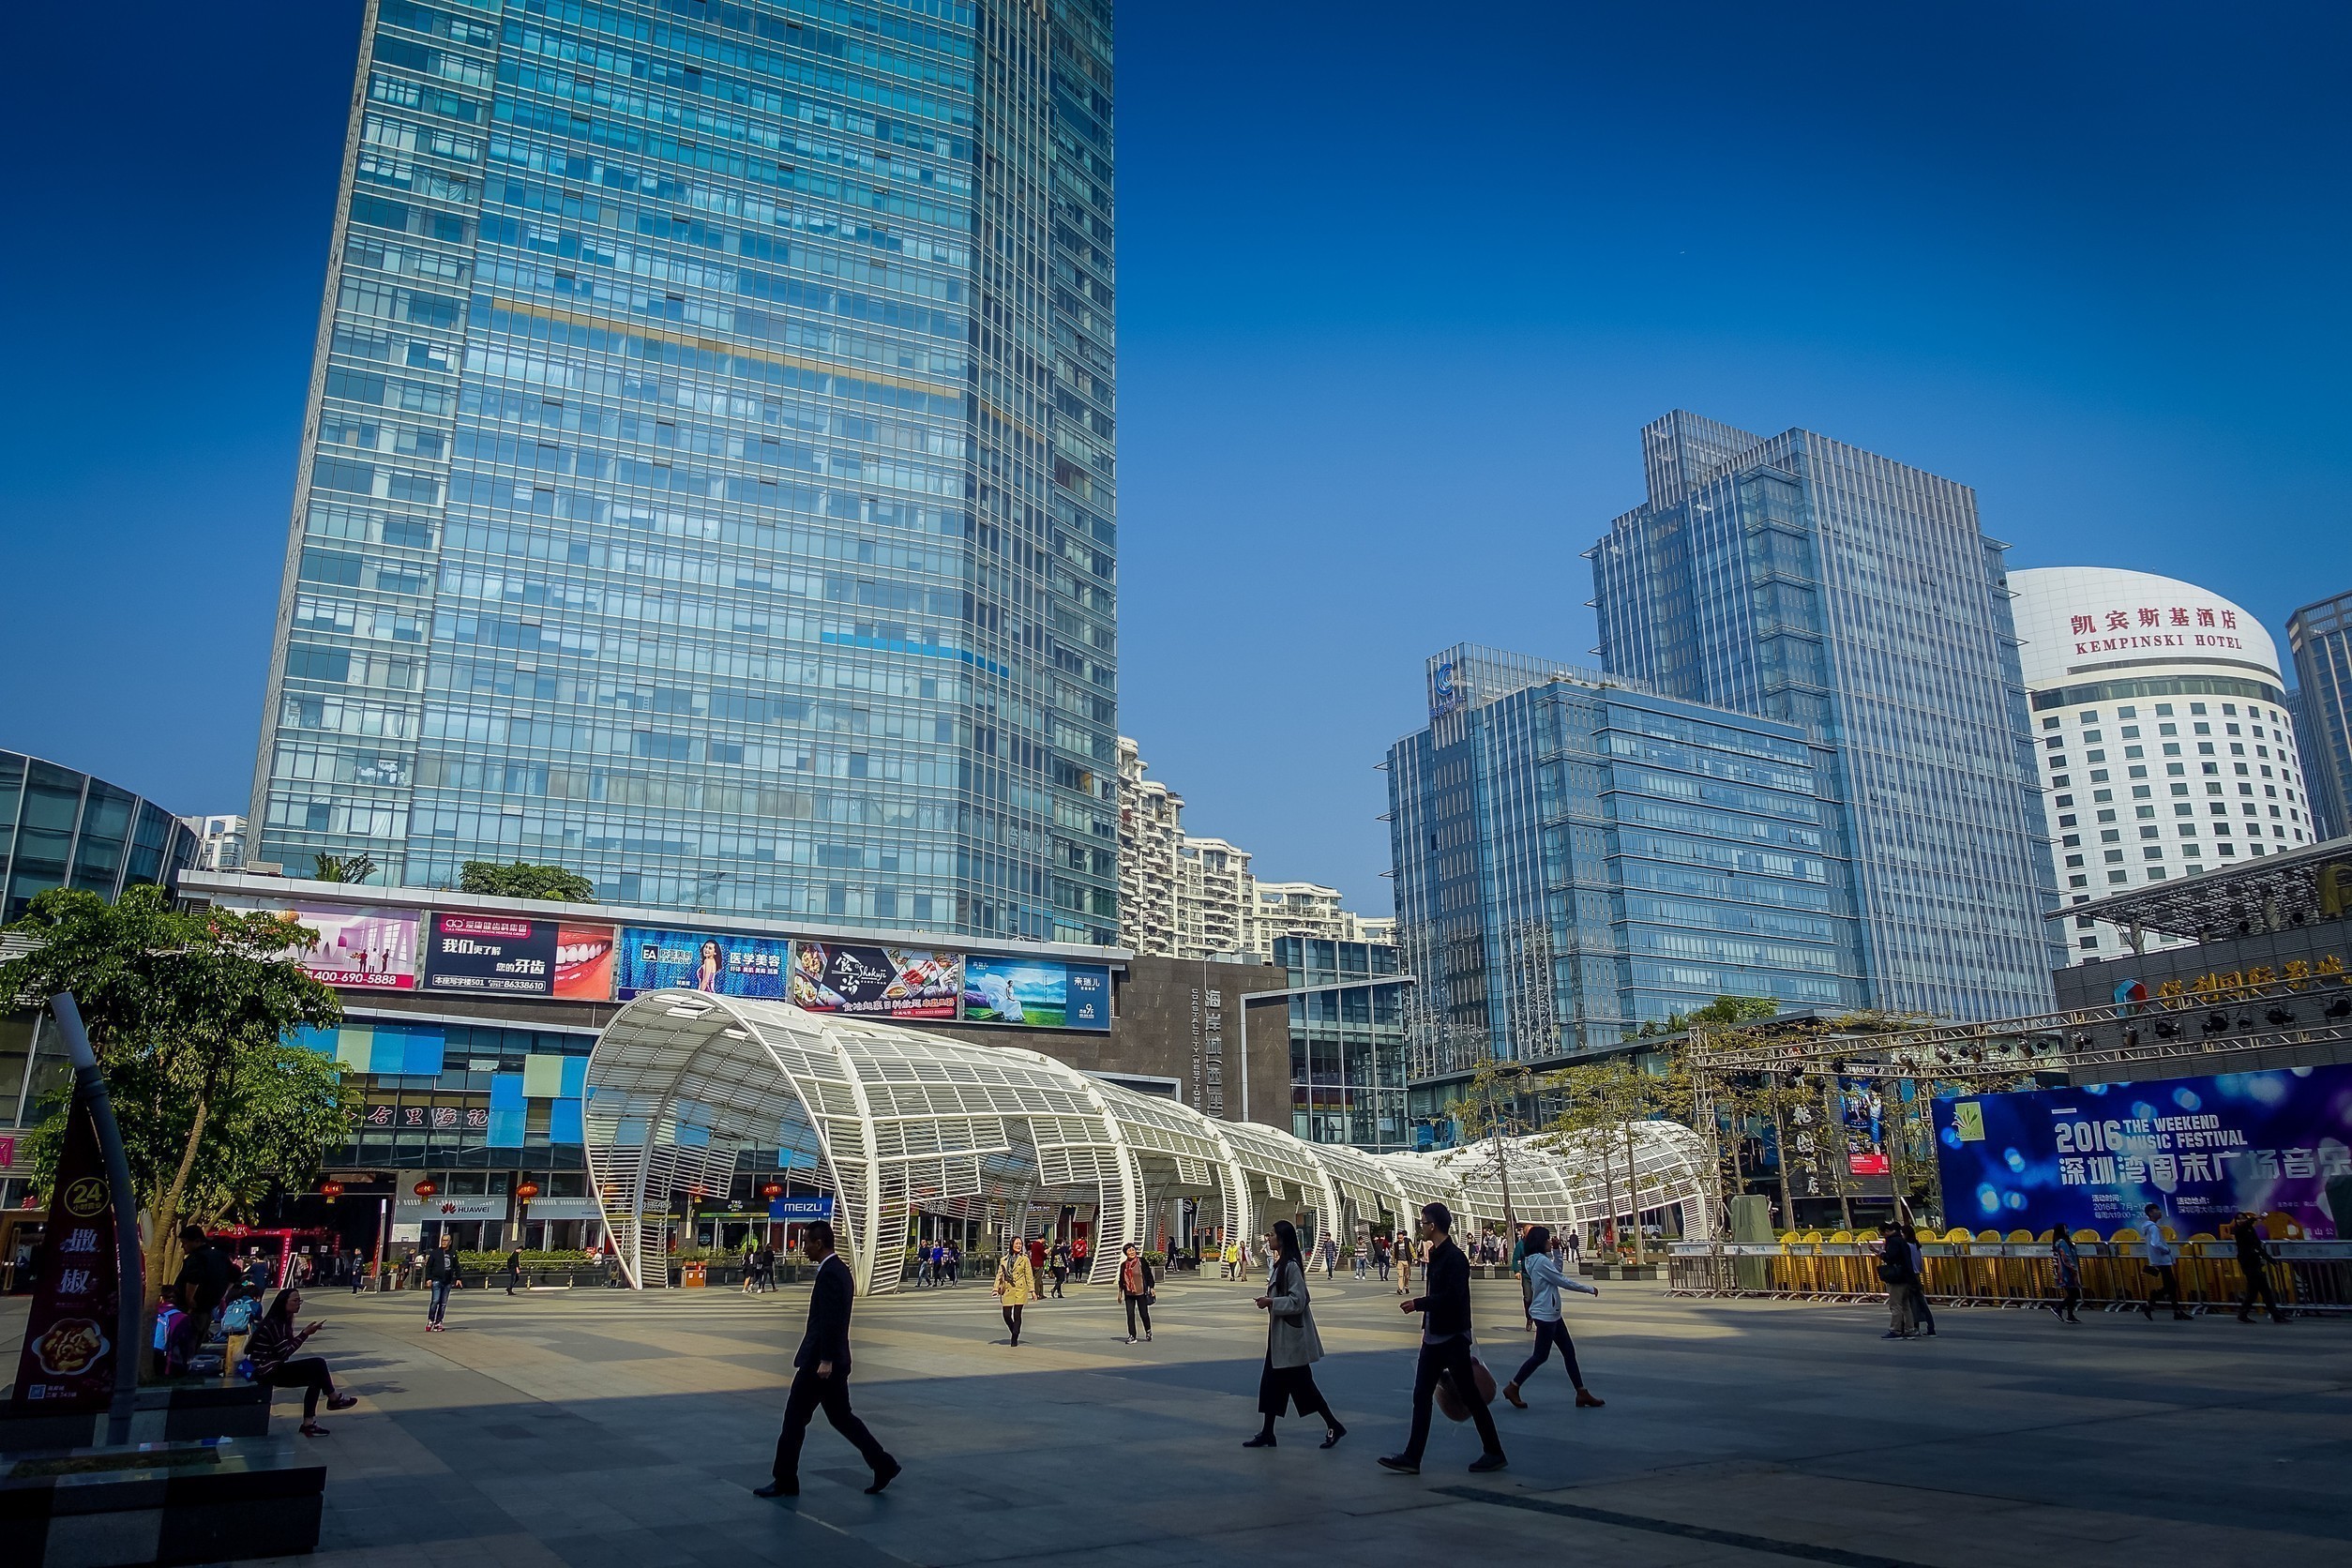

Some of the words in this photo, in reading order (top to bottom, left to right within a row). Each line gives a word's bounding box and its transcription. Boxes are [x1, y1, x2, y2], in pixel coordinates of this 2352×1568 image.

[2071, 607, 2237, 635] 凯宾斯基酒店
[2075, 634, 2184, 655] KEMPINSKI
[2195, 634, 2242, 650] HOTEL
[443, 938, 502, 956] 我们更了解
[642, 949, 656, 960] EA
[496, 958, 545, 974] 您的牙齿
[730, 952, 780, 967] 医学美容
[313, 972, 397, 985] 400-690-5888
[857, 965, 886, 981] Shokuji
[1191, 988, 1199, 1030] COASTAL
[2055, 1120, 2124, 1153] 2016
[2123, 1119, 2149, 1134] THE
[2152, 1114, 2220, 1132] WEEKEND
[2126, 1134, 2171, 1151] MUSIC
[2178, 1130, 2249, 1148] FESTIVAL
[73, 1183, 102, 1204] 24
[784, 1202, 823, 1212] MEIZU
